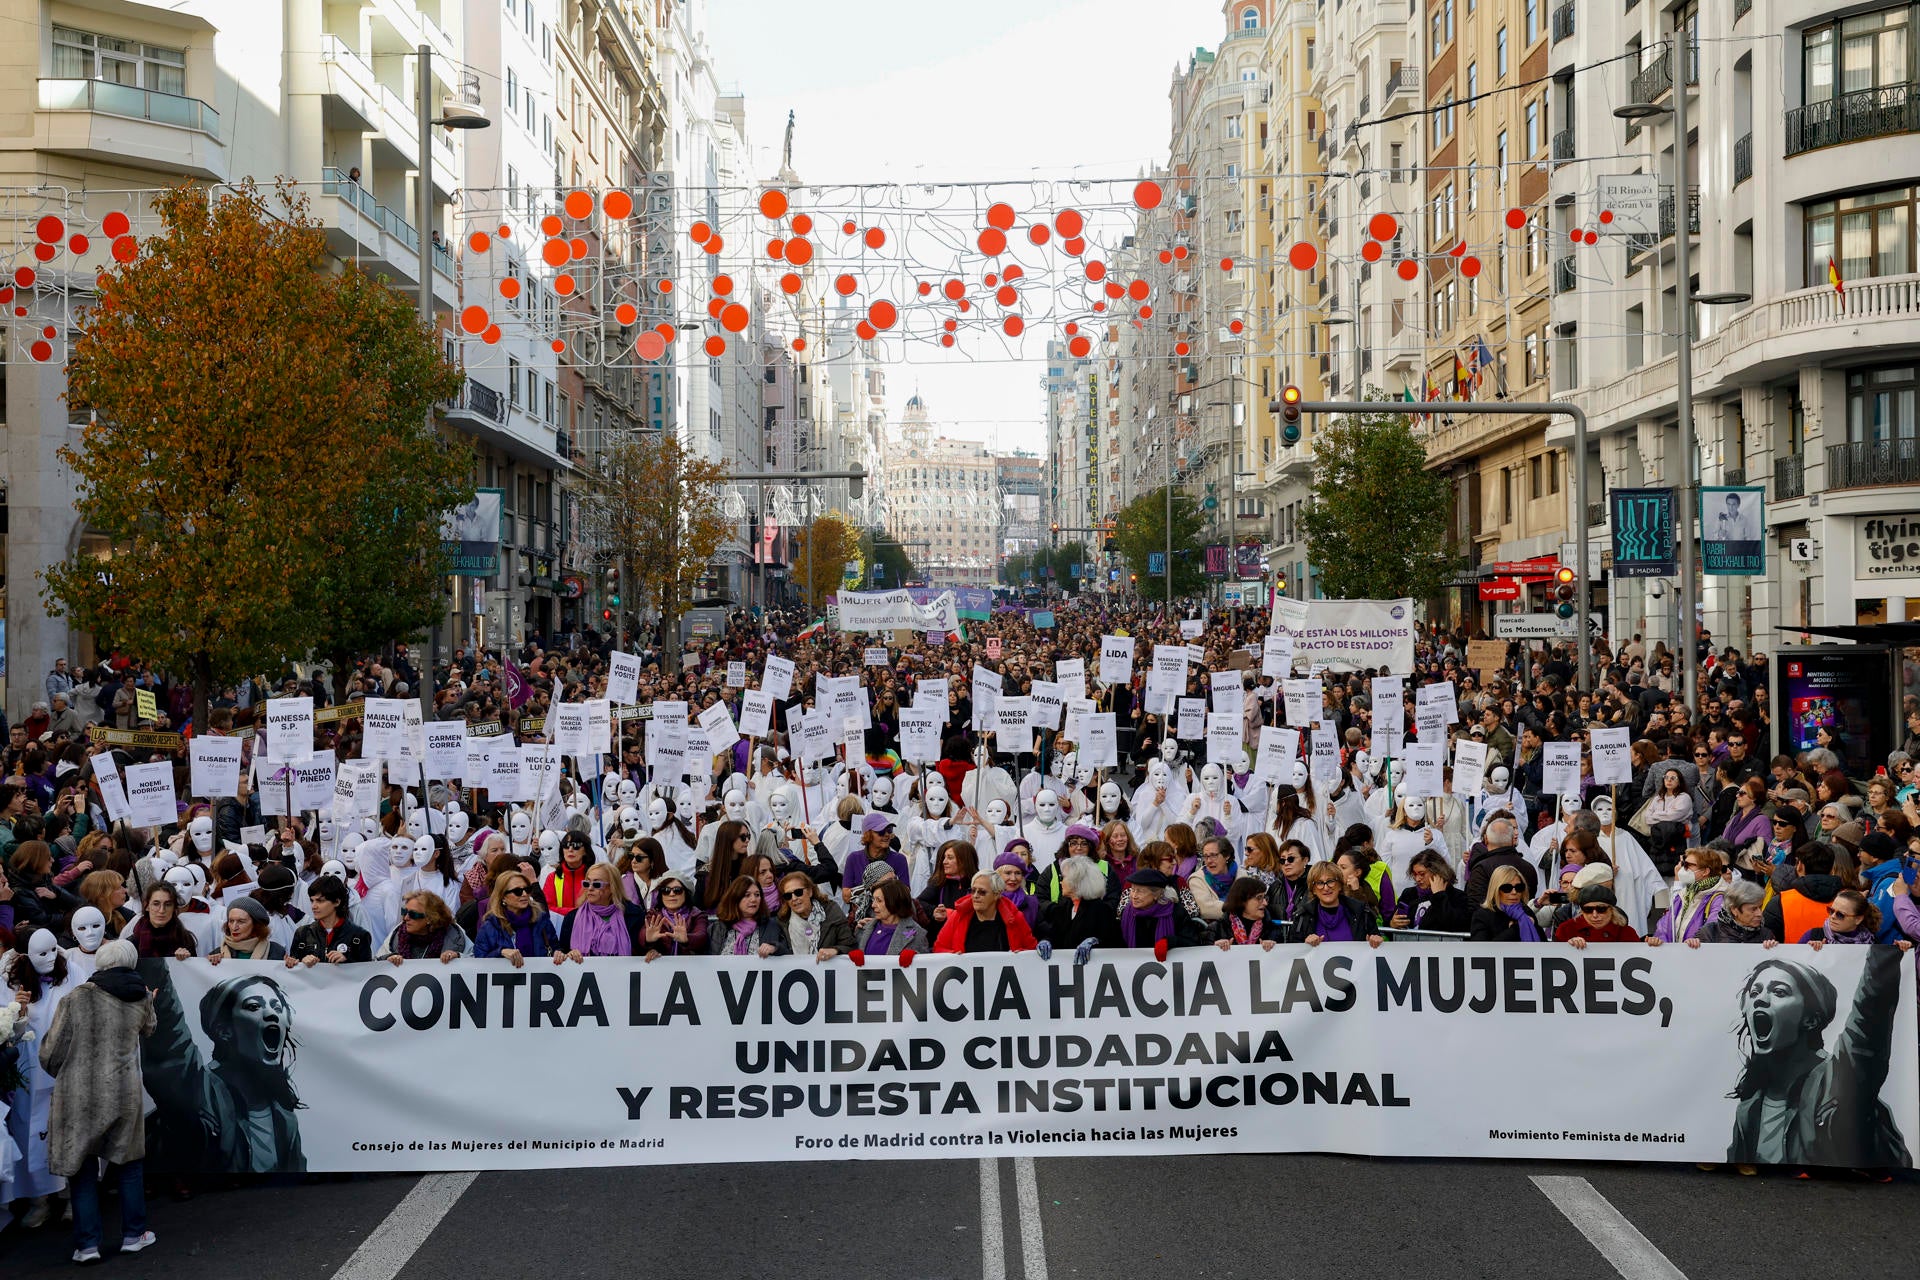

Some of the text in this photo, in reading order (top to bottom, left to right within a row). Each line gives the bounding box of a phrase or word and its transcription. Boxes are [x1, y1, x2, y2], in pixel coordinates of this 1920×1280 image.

[1089, 374, 1098, 529] HOTEL EMPERADOR
[886, 596, 910, 605] VIDA
[849, 616, 894, 625] FEMINISMO
[1341, 629, 1357, 637] LOS
[1360, 629, 1409, 638] MILLONES
[1500, 627, 1556, 635] Los Mostenses
[1301, 641, 1335, 649] PACTO
[1337, 641, 1348, 649] DE
[1351, 641, 1394, 650] ESTADO?
[1106, 650, 1128, 658] LIDA
[1213, 684, 1240, 692] MIGUELA
[269, 714, 311, 723] VANESSA
[474, 723, 500, 736] RESPETO
[94, 730, 107, 741] LAS
[429, 734, 462, 742] CARMEN
[429, 741, 462, 749] CORREA
[1594, 742, 1628, 750] CAROLINA
[198, 755, 238, 763] ELISABETH
[296, 767, 332, 776] PALOMA
[530, 763, 551, 771] LUO
[300, 774, 331, 783] PINEDO
[359, 956, 1672, 1031] CONTRA LA VIOLENCIA HACIA LAS MUJERES,
[736, 1031, 1293, 1074] UNIDAD CIUDADANA
[616, 1072, 1410, 1120] Y RESPUESTA INSTITUCIONAL
[795, 1125, 1239, 1148] Foro de Madrid contra la Violencia hacia las Mujeres
[1489, 1129, 1686, 1144] Movimiento Feminista de Madrid
[352, 1138, 665, 1153] Consejo de las Mujeres del Municipio de Madrid
